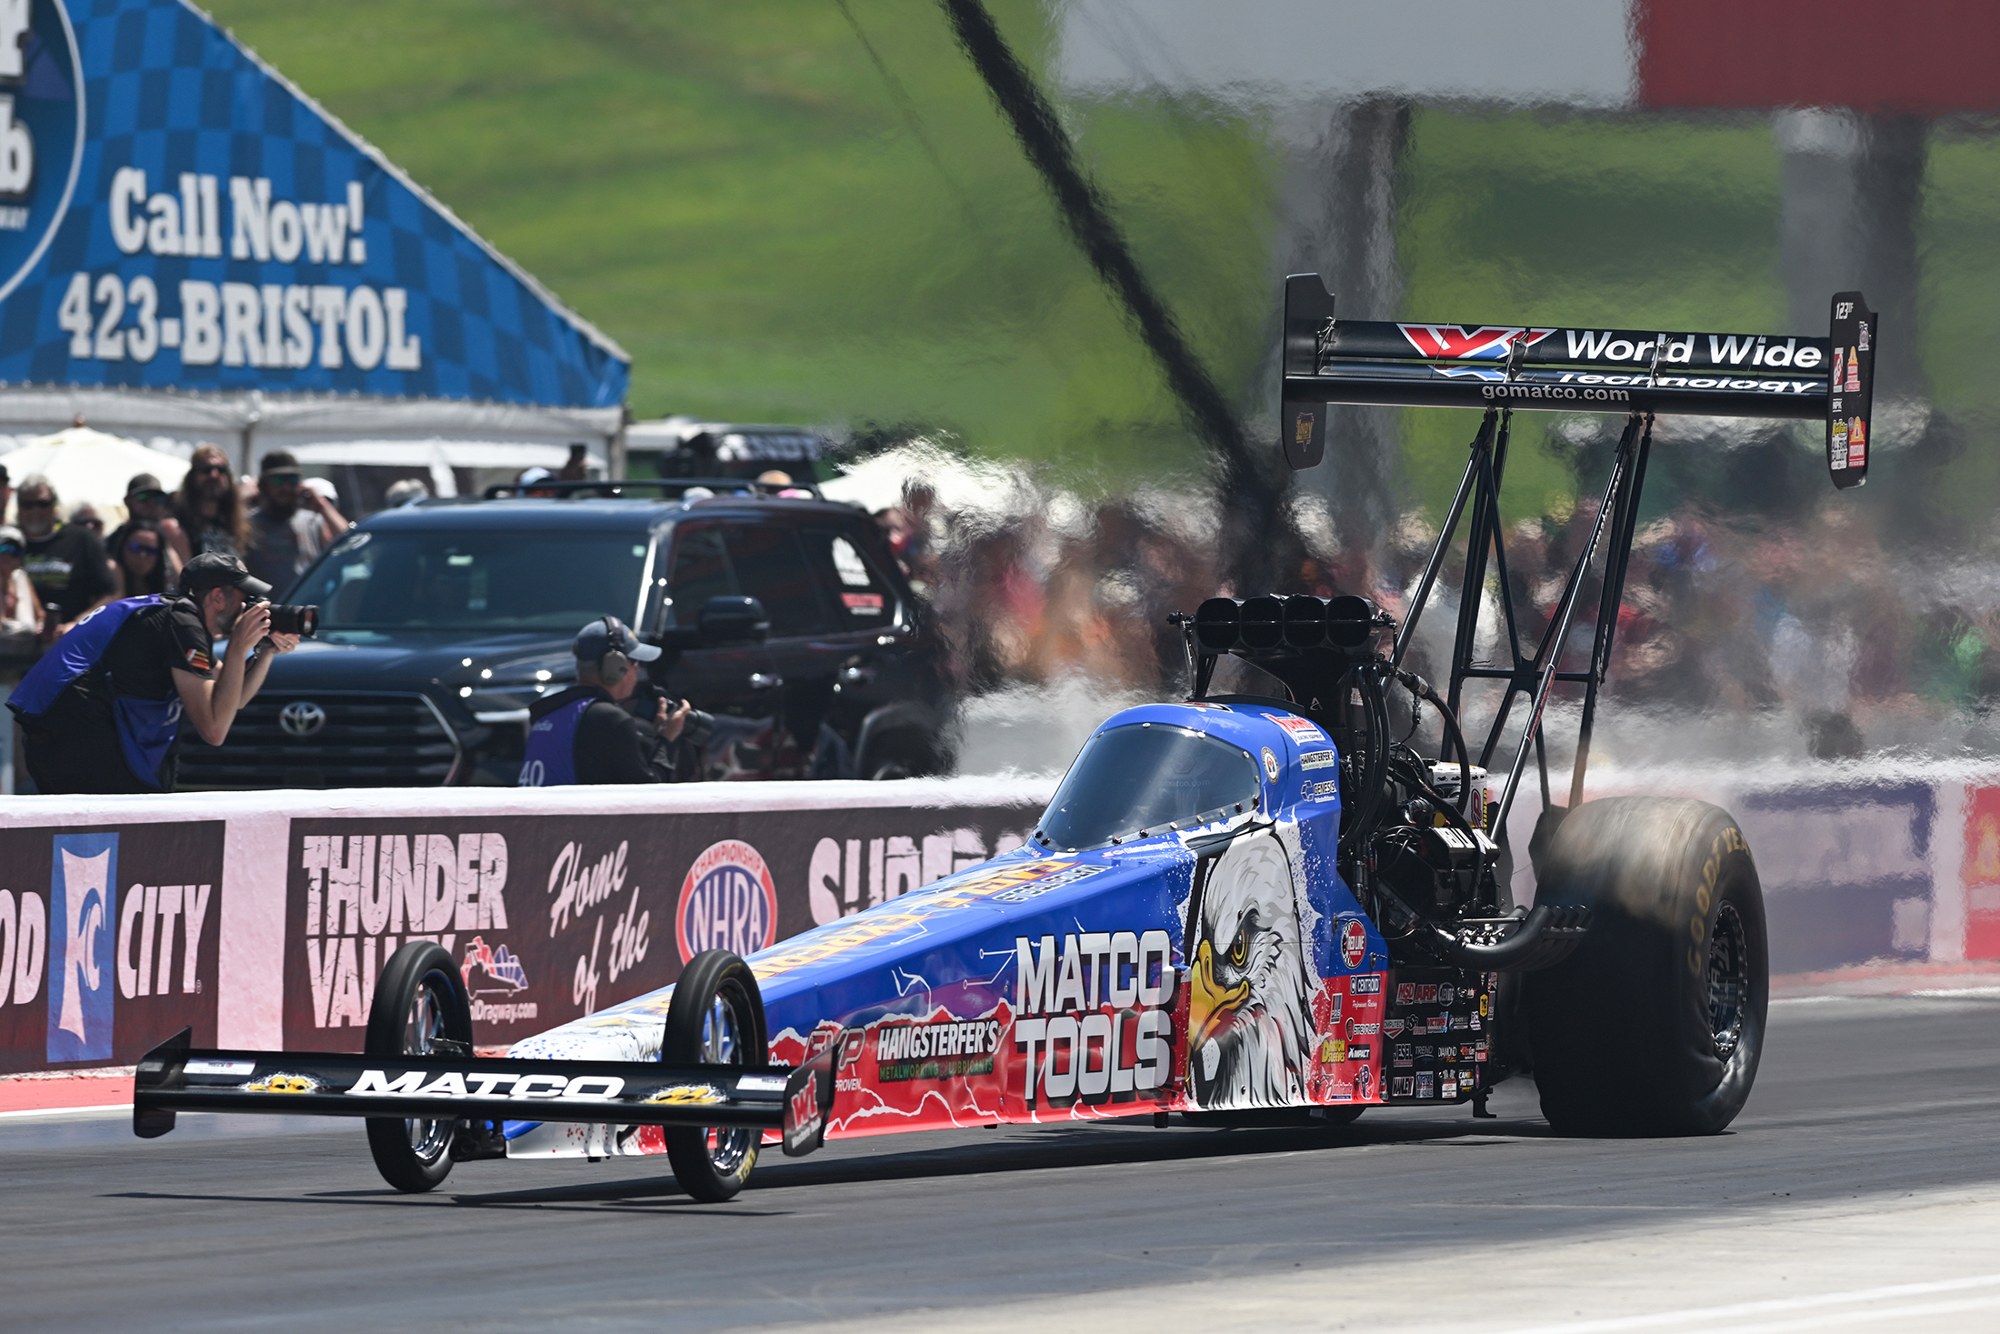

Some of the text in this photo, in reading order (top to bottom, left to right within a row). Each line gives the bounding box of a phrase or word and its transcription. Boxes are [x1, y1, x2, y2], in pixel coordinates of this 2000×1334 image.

[110, 166, 367, 265] Call Now!
[58, 272, 422, 371] 423-BRISTOL
[1566, 330, 1822, 368] World Wide
[1481, 384, 1630, 402] gomatco.com
[1556, 371, 1819, 393] Technology
[517, 759, 545, 786] 40
[303, 833, 508, 935] THUNDER
[548, 840, 629, 939] Home
[692, 870, 763, 960] NHRA
[117, 883, 211, 999] CITY
[573, 914, 604, 1018] of
[608, 886, 650, 983] the
[1015, 930, 1175, 1016] MATCO
[877, 1020, 1000, 1061] HANGSTERFER'S
[879, 1058, 994, 1082] METALWORKING LUBRICANTS
[1015, 1010, 1172, 1100] TOOLS
[344, 1070, 626, 1100] MATCO
